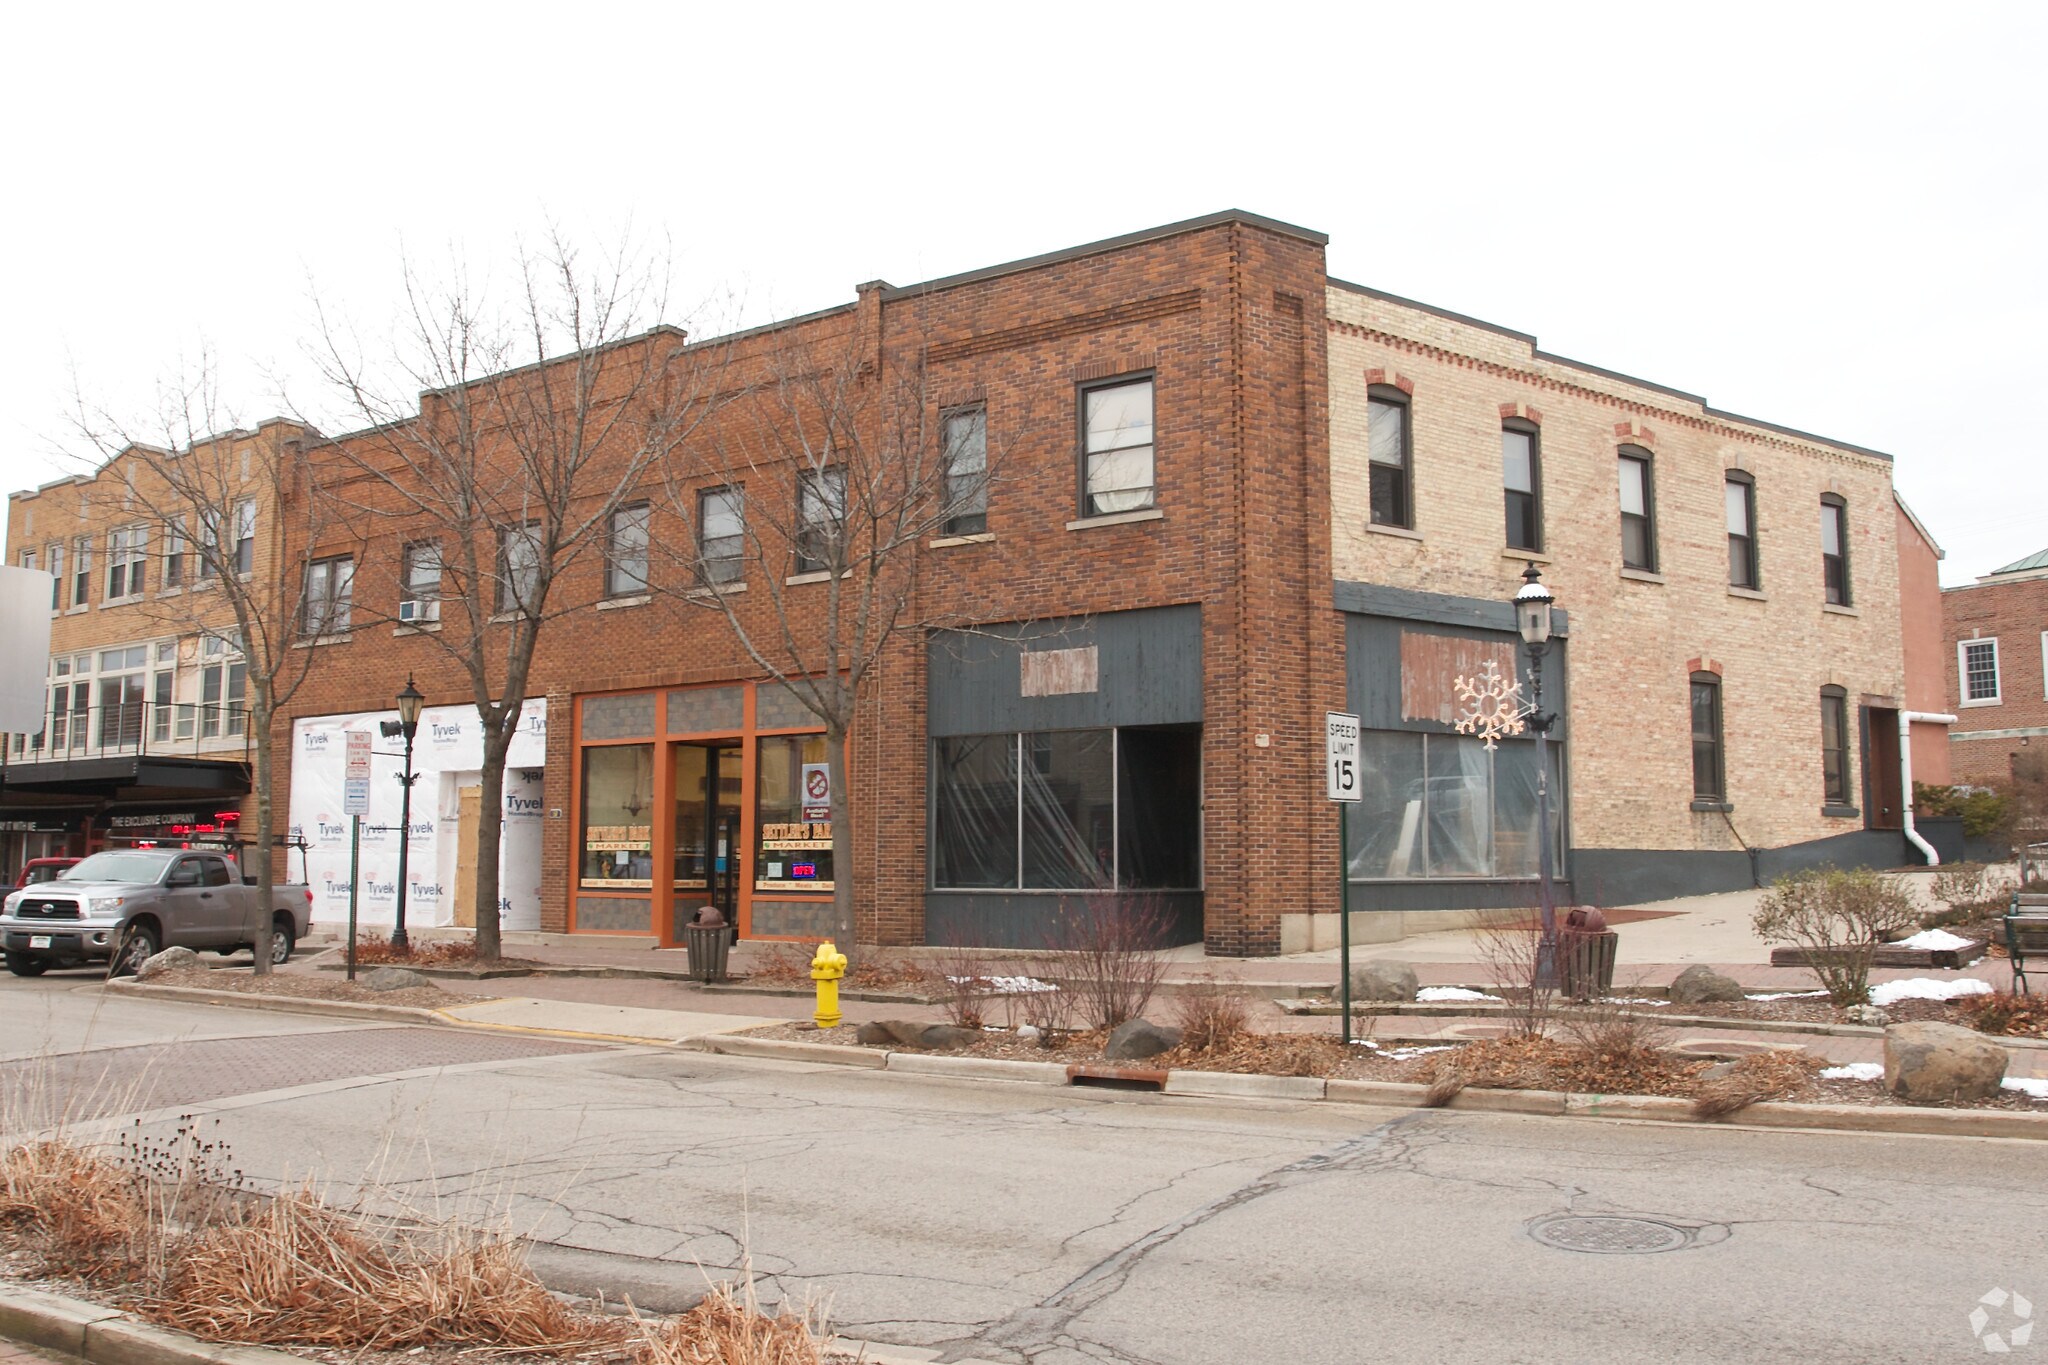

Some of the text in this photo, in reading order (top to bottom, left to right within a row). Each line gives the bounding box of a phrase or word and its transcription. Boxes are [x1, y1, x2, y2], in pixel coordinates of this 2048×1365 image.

[432, 723, 461, 738] Tyvek
[1330, 723, 1357, 738] SPEED
[305, 733, 328, 746] Tyvek
[1333, 741, 1354, 755] LIMIT
[1334, 760, 1354, 791] 15
[112, 816, 123, 827] THE
[162, 813, 196, 824] COMPANY
[319, 823, 344, 836] Tyvek
[360, 822, 387, 836] Tyvek
[408, 822, 433, 835] yvek
[794, 866, 815, 875] OPEN
[326, 881, 352, 895] Tyvek
[368, 881, 395, 895] Tyvek
[411, 883, 443, 897] Tyvek
